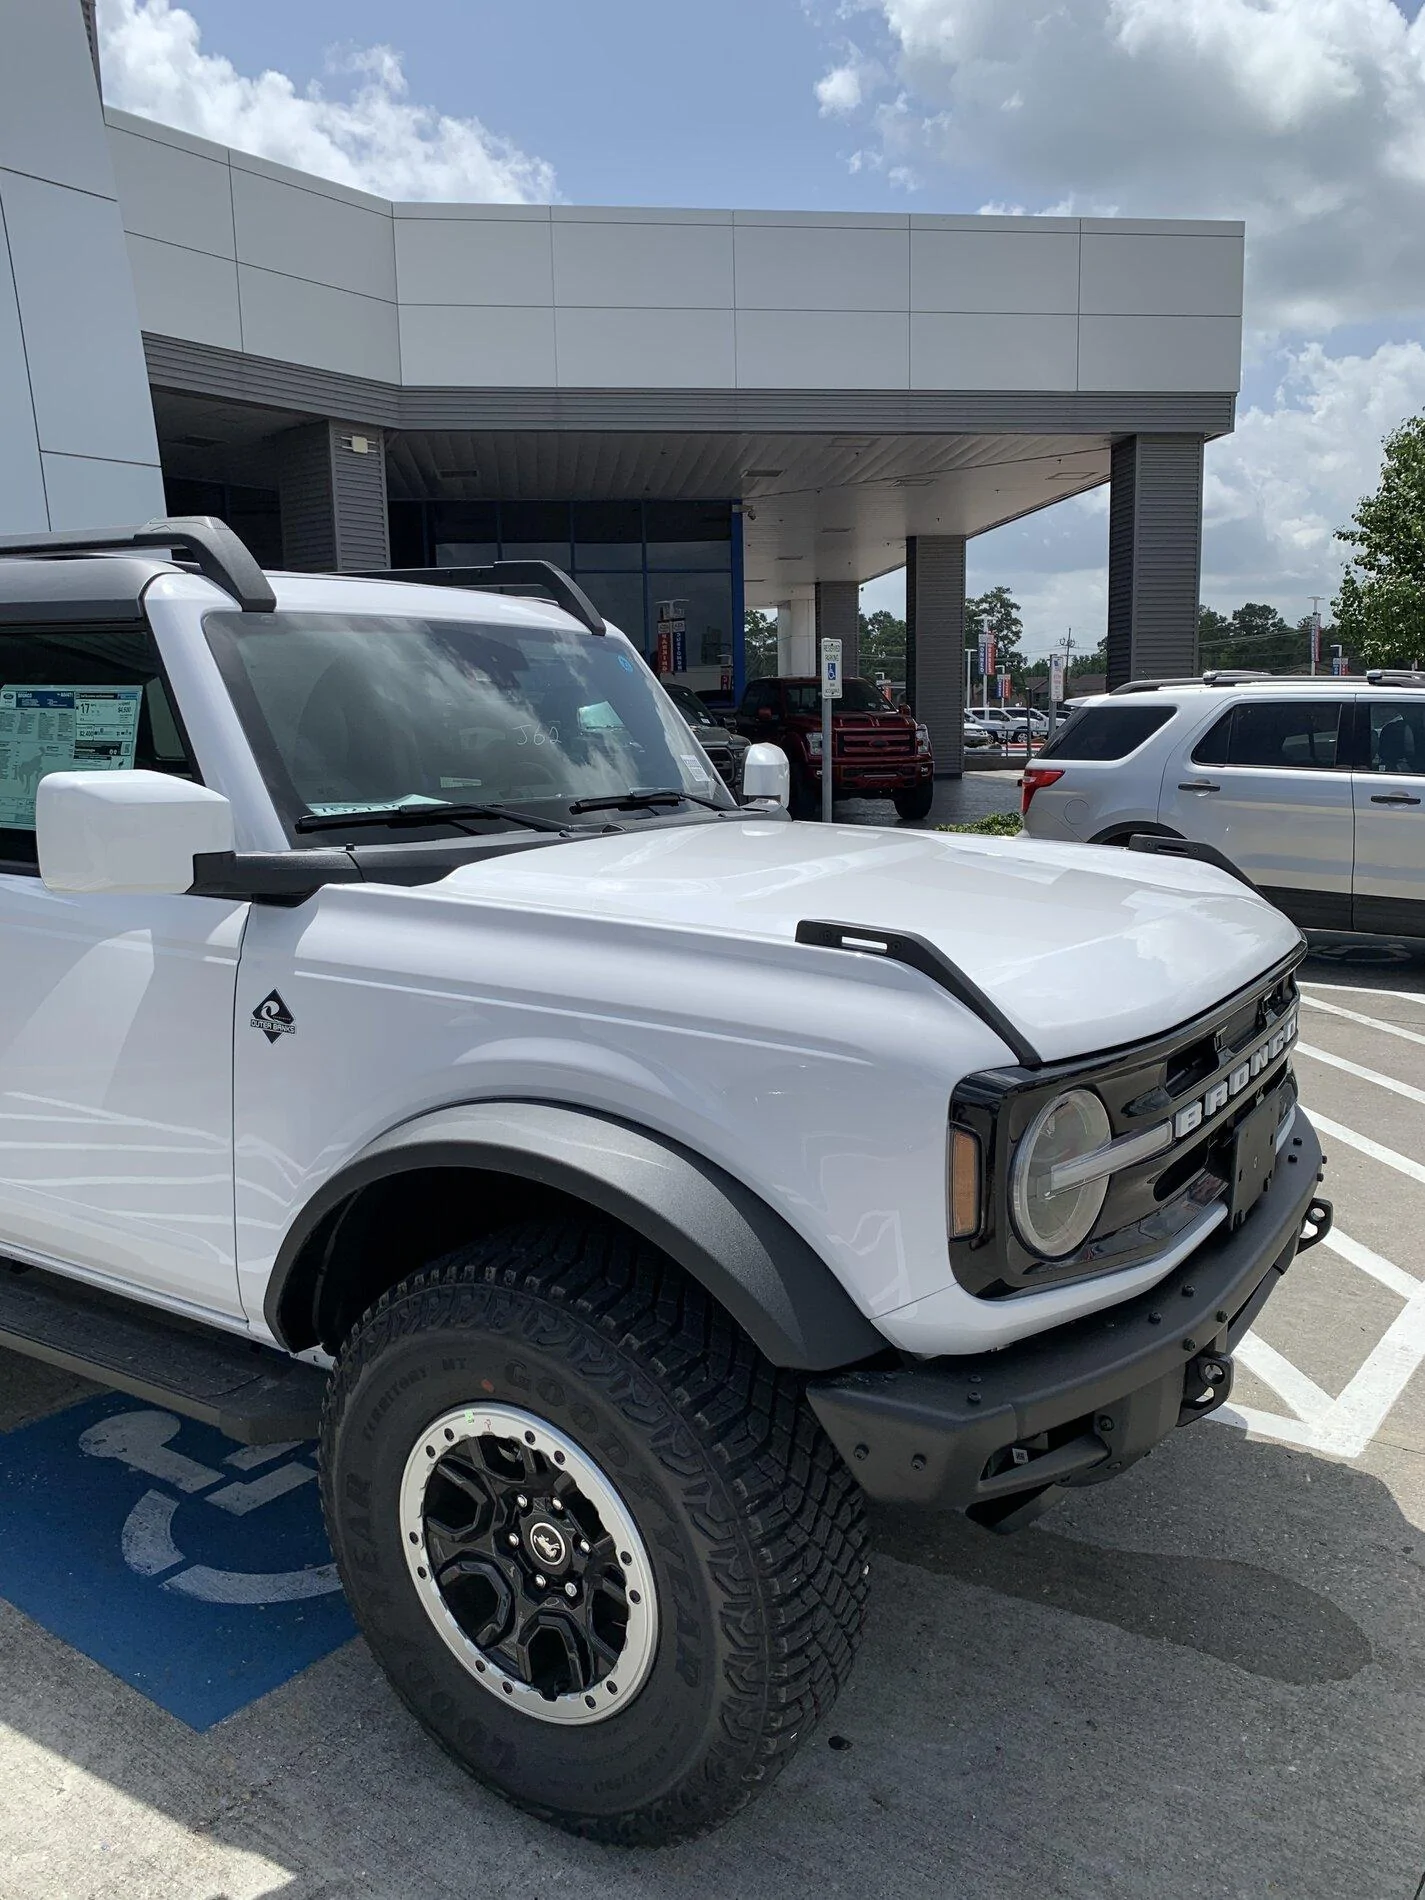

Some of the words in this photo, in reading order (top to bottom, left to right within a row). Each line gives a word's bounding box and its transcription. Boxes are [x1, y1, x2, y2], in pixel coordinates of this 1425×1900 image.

[80, 703, 90, 714] 17
[251, 1019, 272, 1030] OUTER
[272, 1023, 296, 1034] BANKS
[1174, 1017, 1297, 1138] BRONCO
[503, 1358, 704, 1689] GOODYEAR
